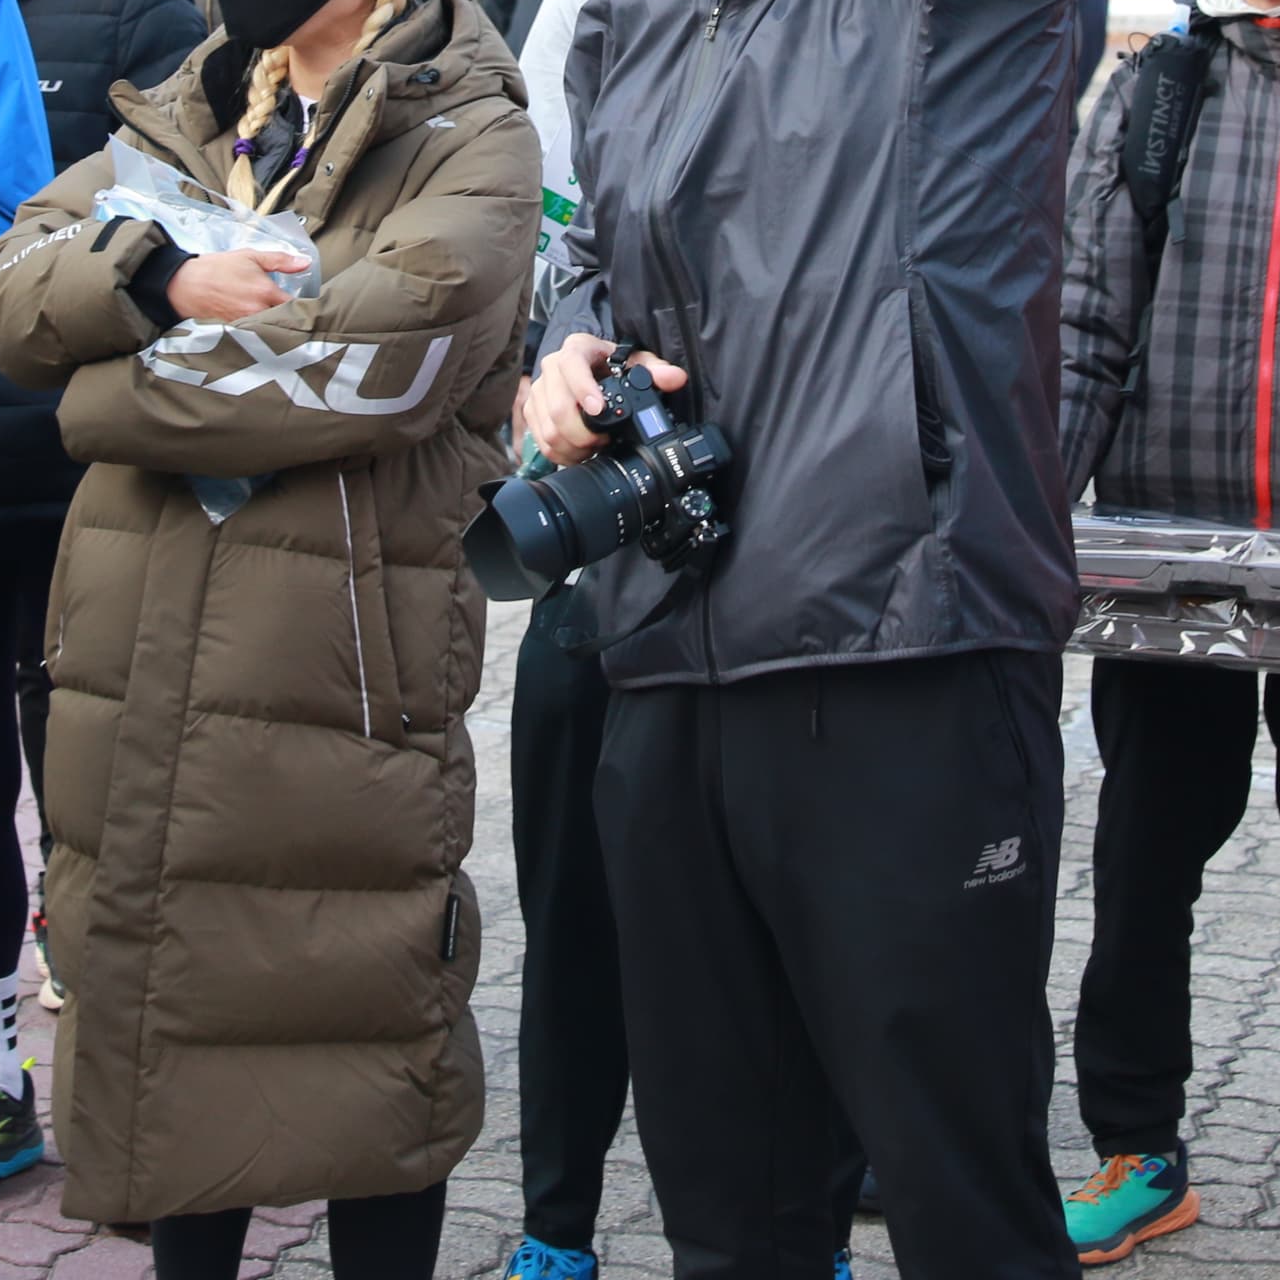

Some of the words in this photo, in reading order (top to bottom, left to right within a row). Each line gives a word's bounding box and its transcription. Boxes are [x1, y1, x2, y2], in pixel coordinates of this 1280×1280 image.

[138, 318, 454, 416] 2XU
[664, 446, 686, 478] Nikon
[963, 876, 987, 889] new
